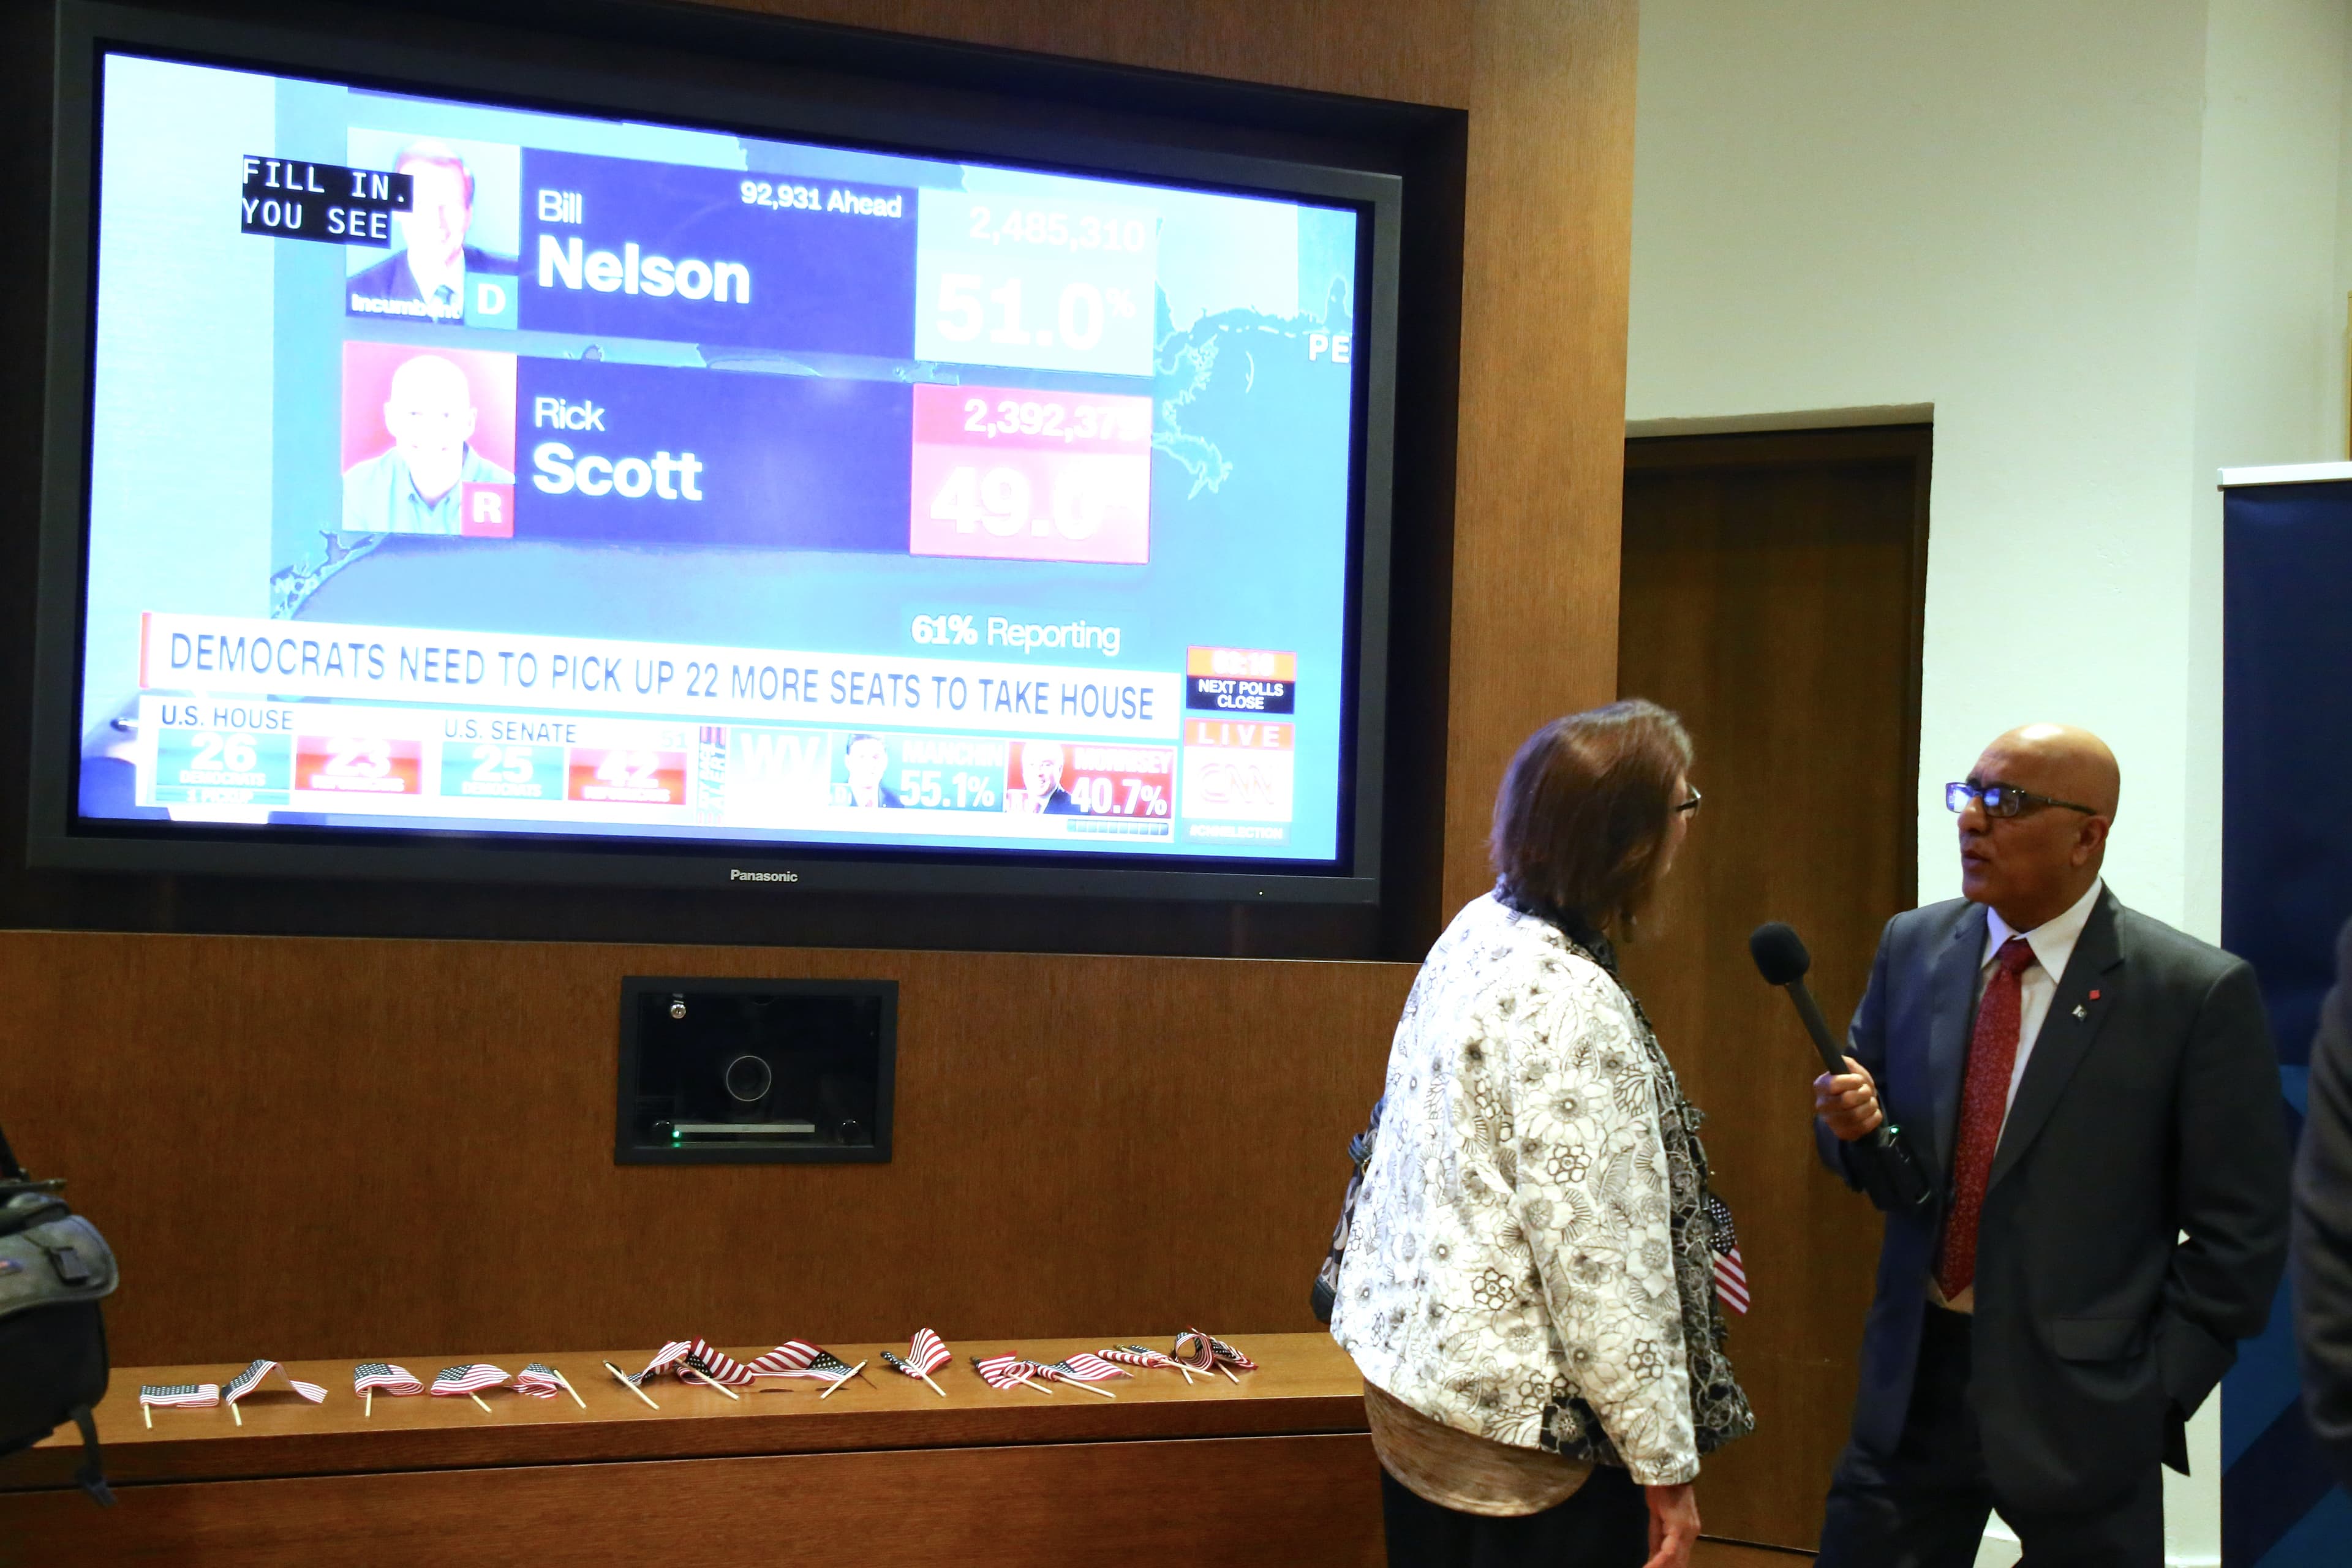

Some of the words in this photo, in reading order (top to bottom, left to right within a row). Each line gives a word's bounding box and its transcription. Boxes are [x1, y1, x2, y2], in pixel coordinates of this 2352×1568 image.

[242, 159, 324, 194] FILL
[352, 174, 407, 204] IN.
[741, 181, 821, 212] 92,931
[827, 189, 902, 219] Ahead
[241, 198, 302, 230] YOU
[328, 209, 388, 239] SEE
[538, 189, 582, 224] Bill
[970, 206, 1146, 252] 2,485,310
[538, 235, 750, 304] Nelson
[478, 284, 505, 314] D
[535, 397, 606, 432] Rick
[533, 442, 703, 501] Scott
[473, 492, 502, 524] R
[911, 614, 978, 646] 61%
[987, 617, 1121, 657] Reporting
[170, 632, 385, 680] DEMOCRATS
[399, 646, 484, 685] NEED
[499, 650, 538, 688] TO
[552, 655, 622, 693] PICK
[635, 659, 674, 695] UP
[686, 662, 718, 698] 22
[731, 665, 819, 704] MORE
[830, 669, 921, 709] SEATS
[931, 675, 968, 711] TO
[978, 678, 1050, 715] TAKE
[1060, 682, 1155, 720] HOUSE
[1199, 679, 1236, 694] NEXT
[1239, 682, 1284, 696] POLLS
[161, 704, 205, 726] U.S.
[213, 707, 295, 730] HOUSE
[1217, 695, 1264, 709] CLOSE
[444, 718, 483, 740] U.S.
[491, 720, 578, 744] SENATE
[1198, 722, 1280, 747] LIVE
[191, 731, 257, 772] 26
[472, 744, 533, 782] 25
[900, 769, 995, 808] 55.1%
[1071, 777, 1168, 815] 40.7%
[731, 869, 799, 883] Panasonic
